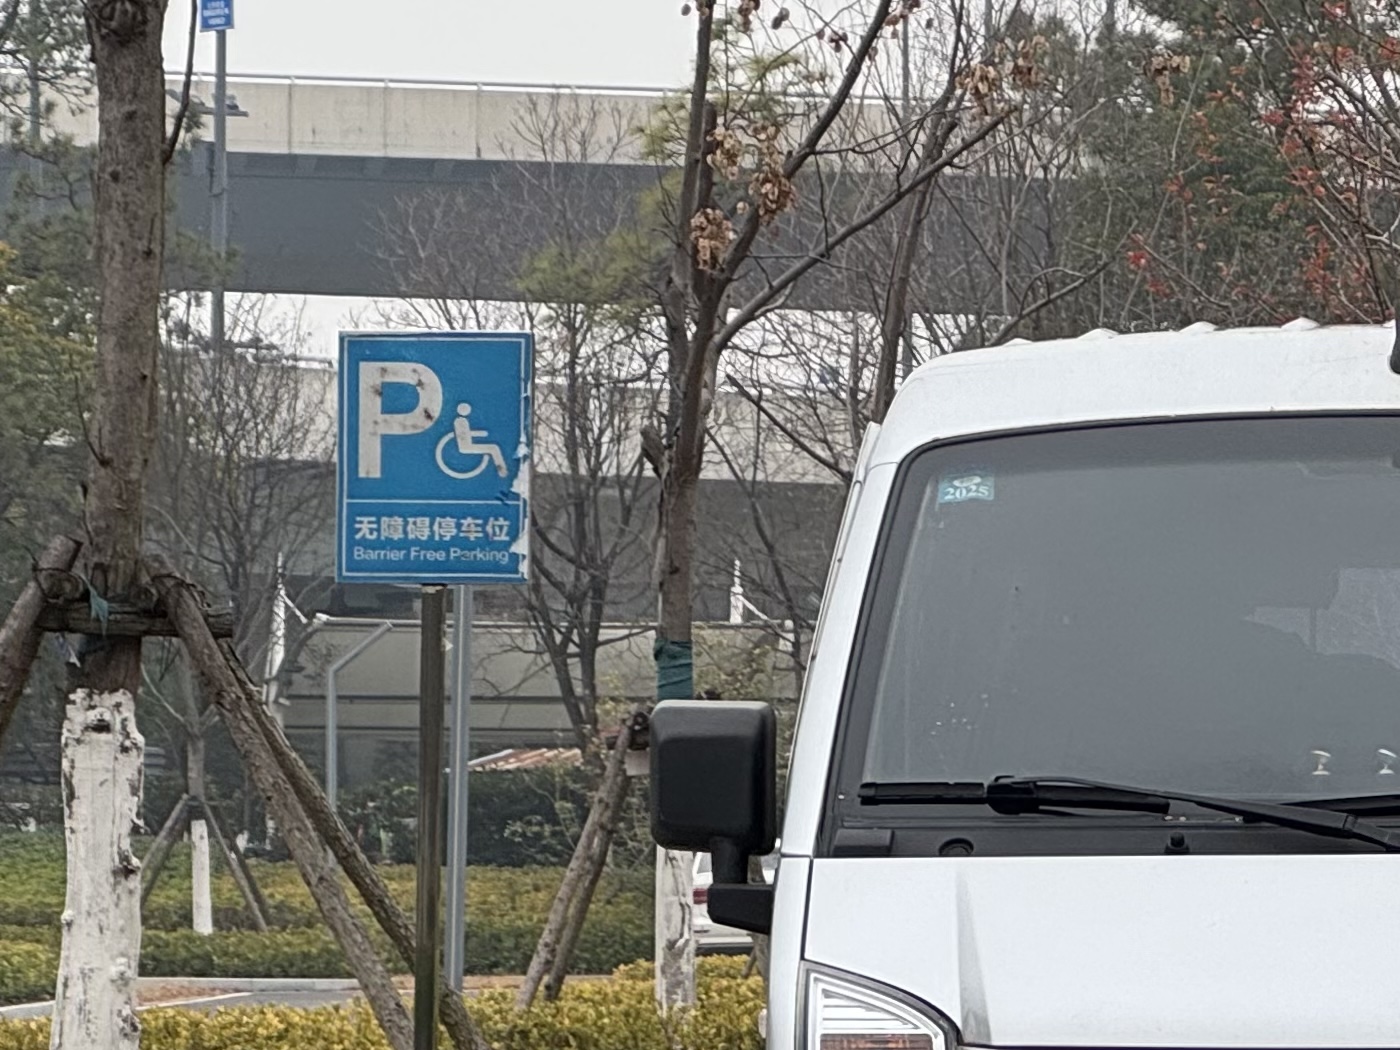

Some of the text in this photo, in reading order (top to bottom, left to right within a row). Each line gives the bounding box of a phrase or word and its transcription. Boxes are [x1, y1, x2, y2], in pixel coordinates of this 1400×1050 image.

[358, 361, 443, 478] P
[944, 484, 989, 500] 2025
[354, 516, 510, 541] 无障碍停车位
[353, 546, 509, 564] Barrier Free Parking
